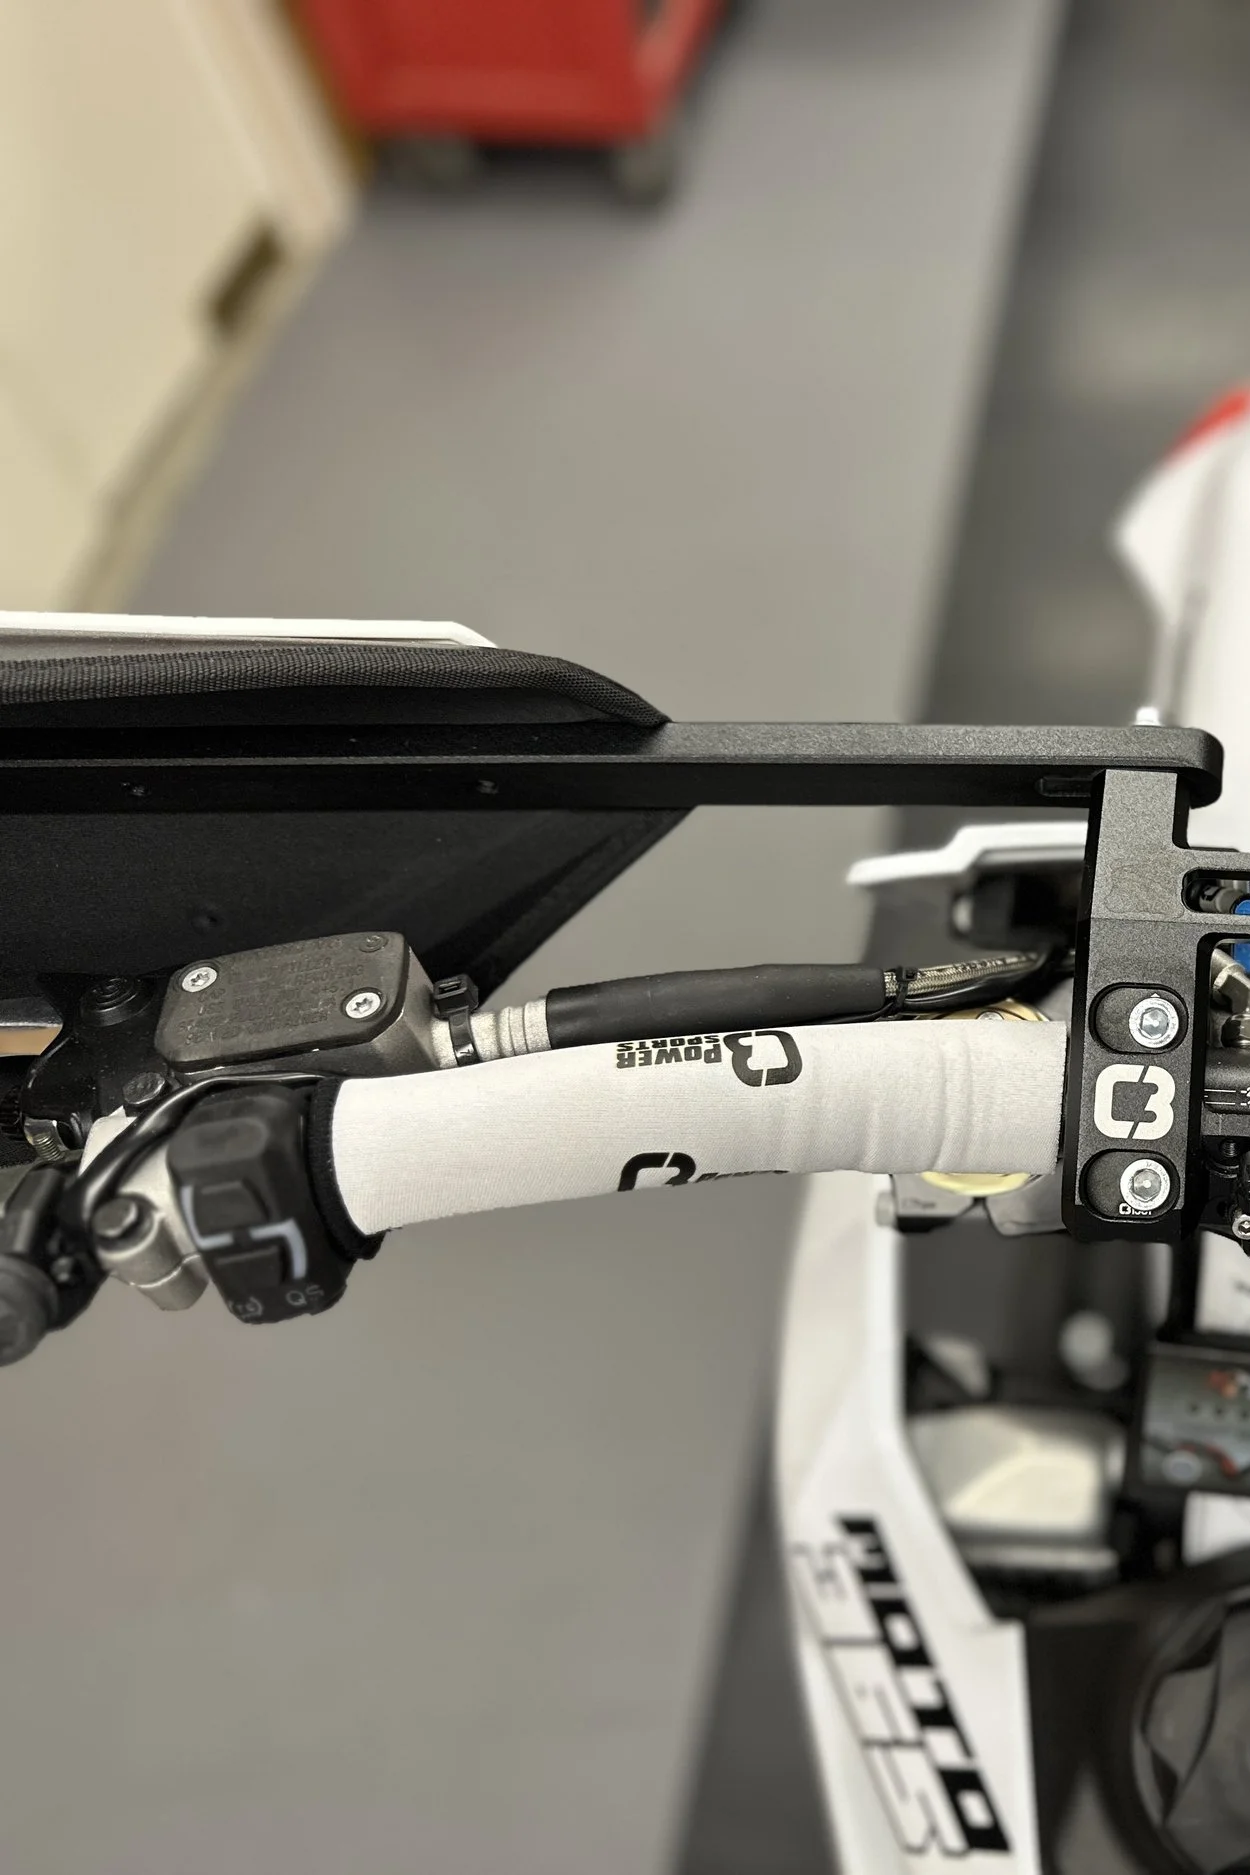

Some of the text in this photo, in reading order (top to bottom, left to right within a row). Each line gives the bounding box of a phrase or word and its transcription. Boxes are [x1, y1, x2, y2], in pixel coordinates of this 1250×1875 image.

[615, 1043, 723, 1069] POWER
[616, 1035, 721, 1052] SPORTS
[833, 1513, 1012, 1853] MOTO
